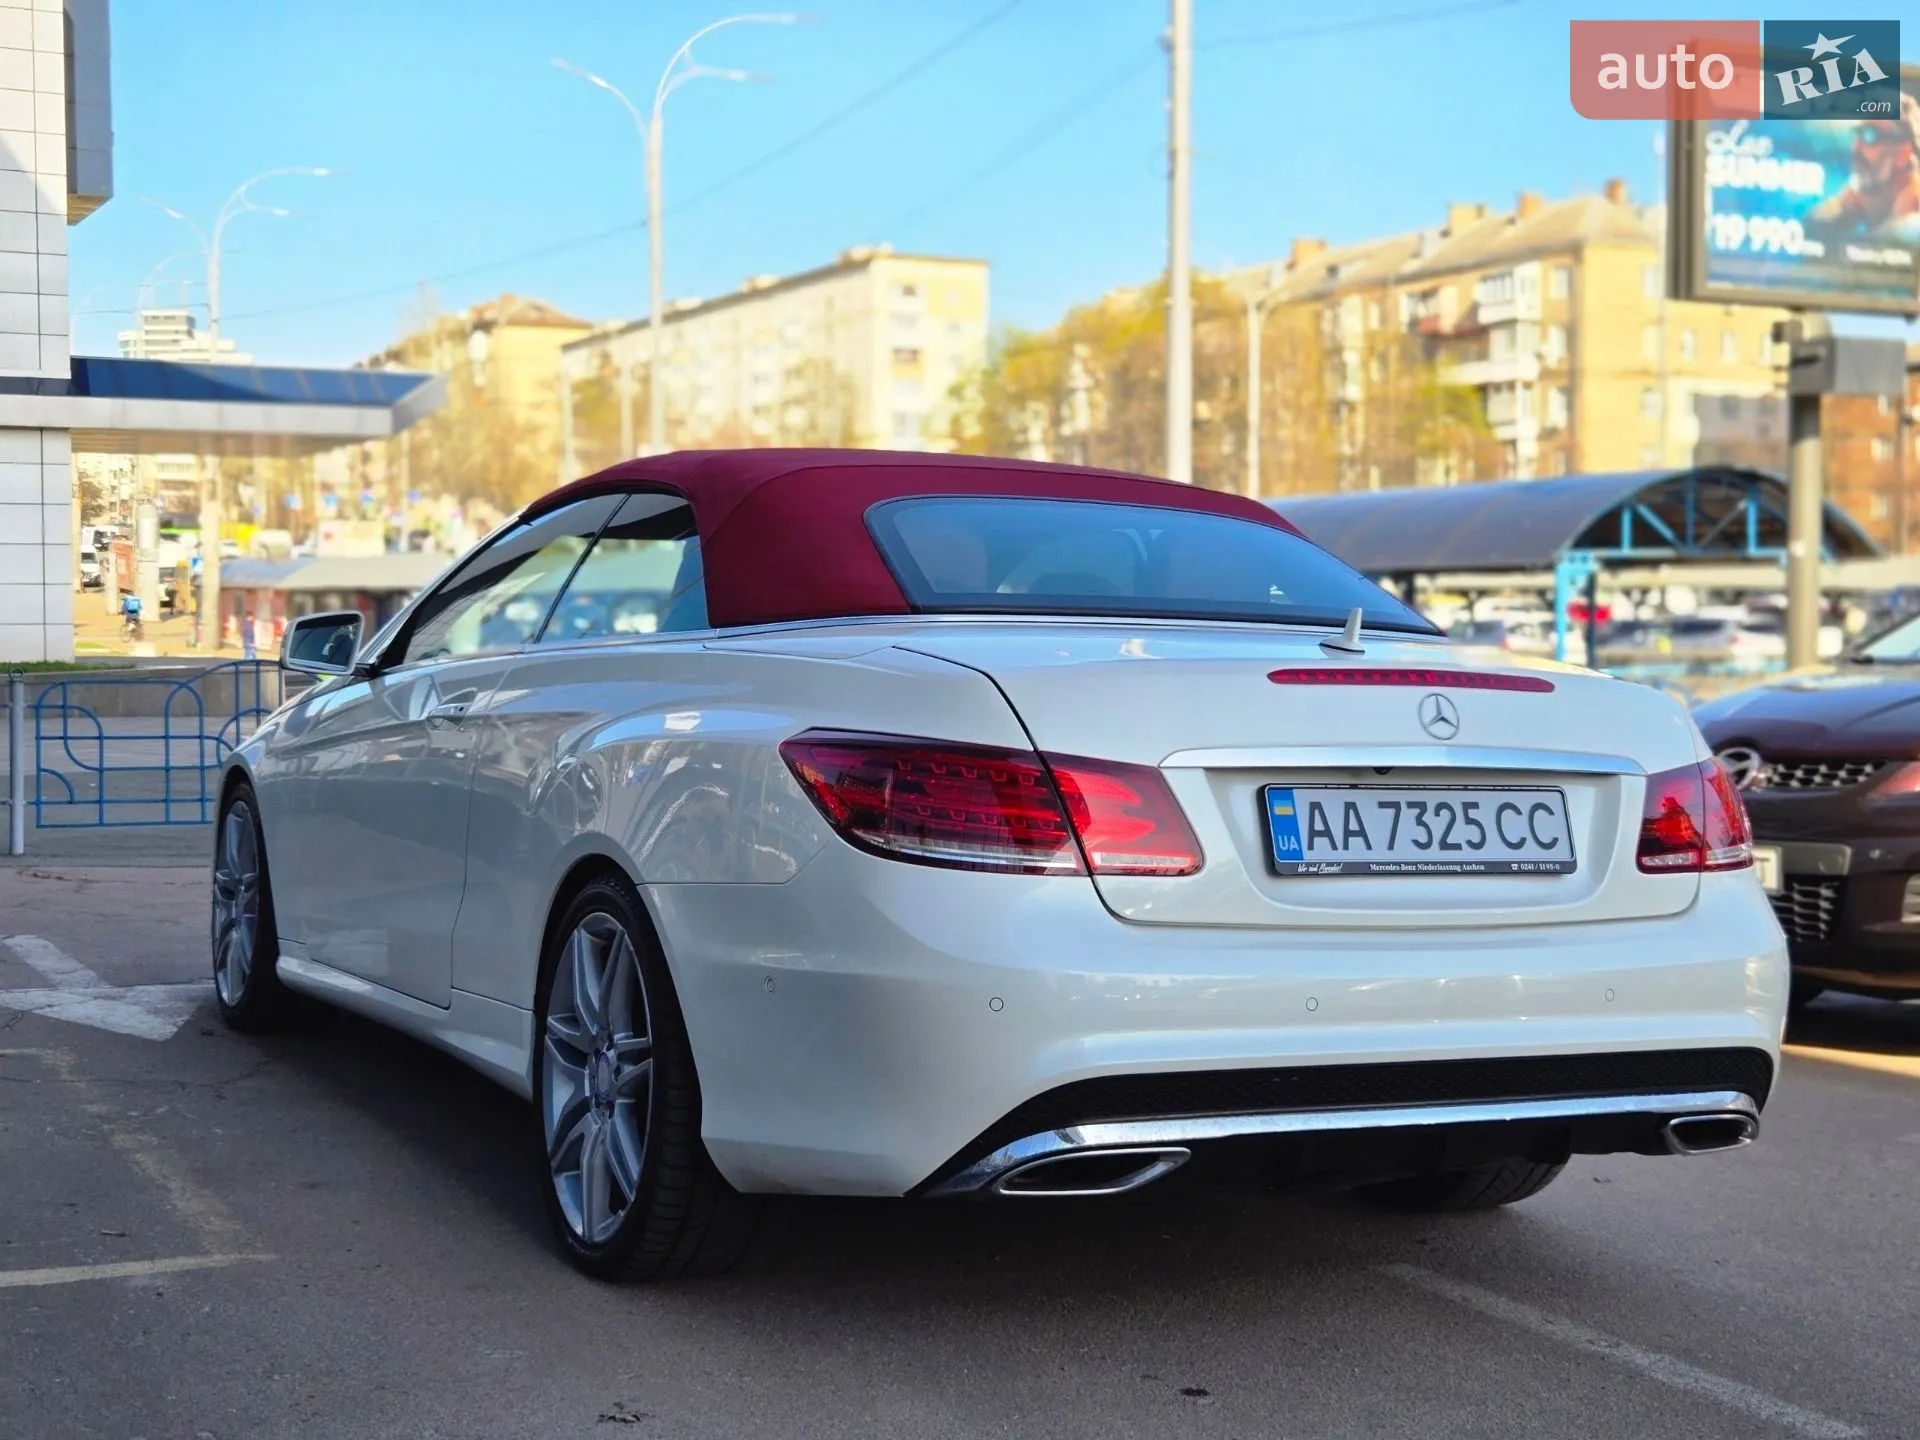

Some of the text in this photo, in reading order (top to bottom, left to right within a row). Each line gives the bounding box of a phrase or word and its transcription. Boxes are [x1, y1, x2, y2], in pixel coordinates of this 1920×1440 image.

[1307, 801, 1559, 851] AA 7325 CC
[1278, 835, 1299, 850] UA
[1369, 863, 1416, 871] Mercedes-Benz
